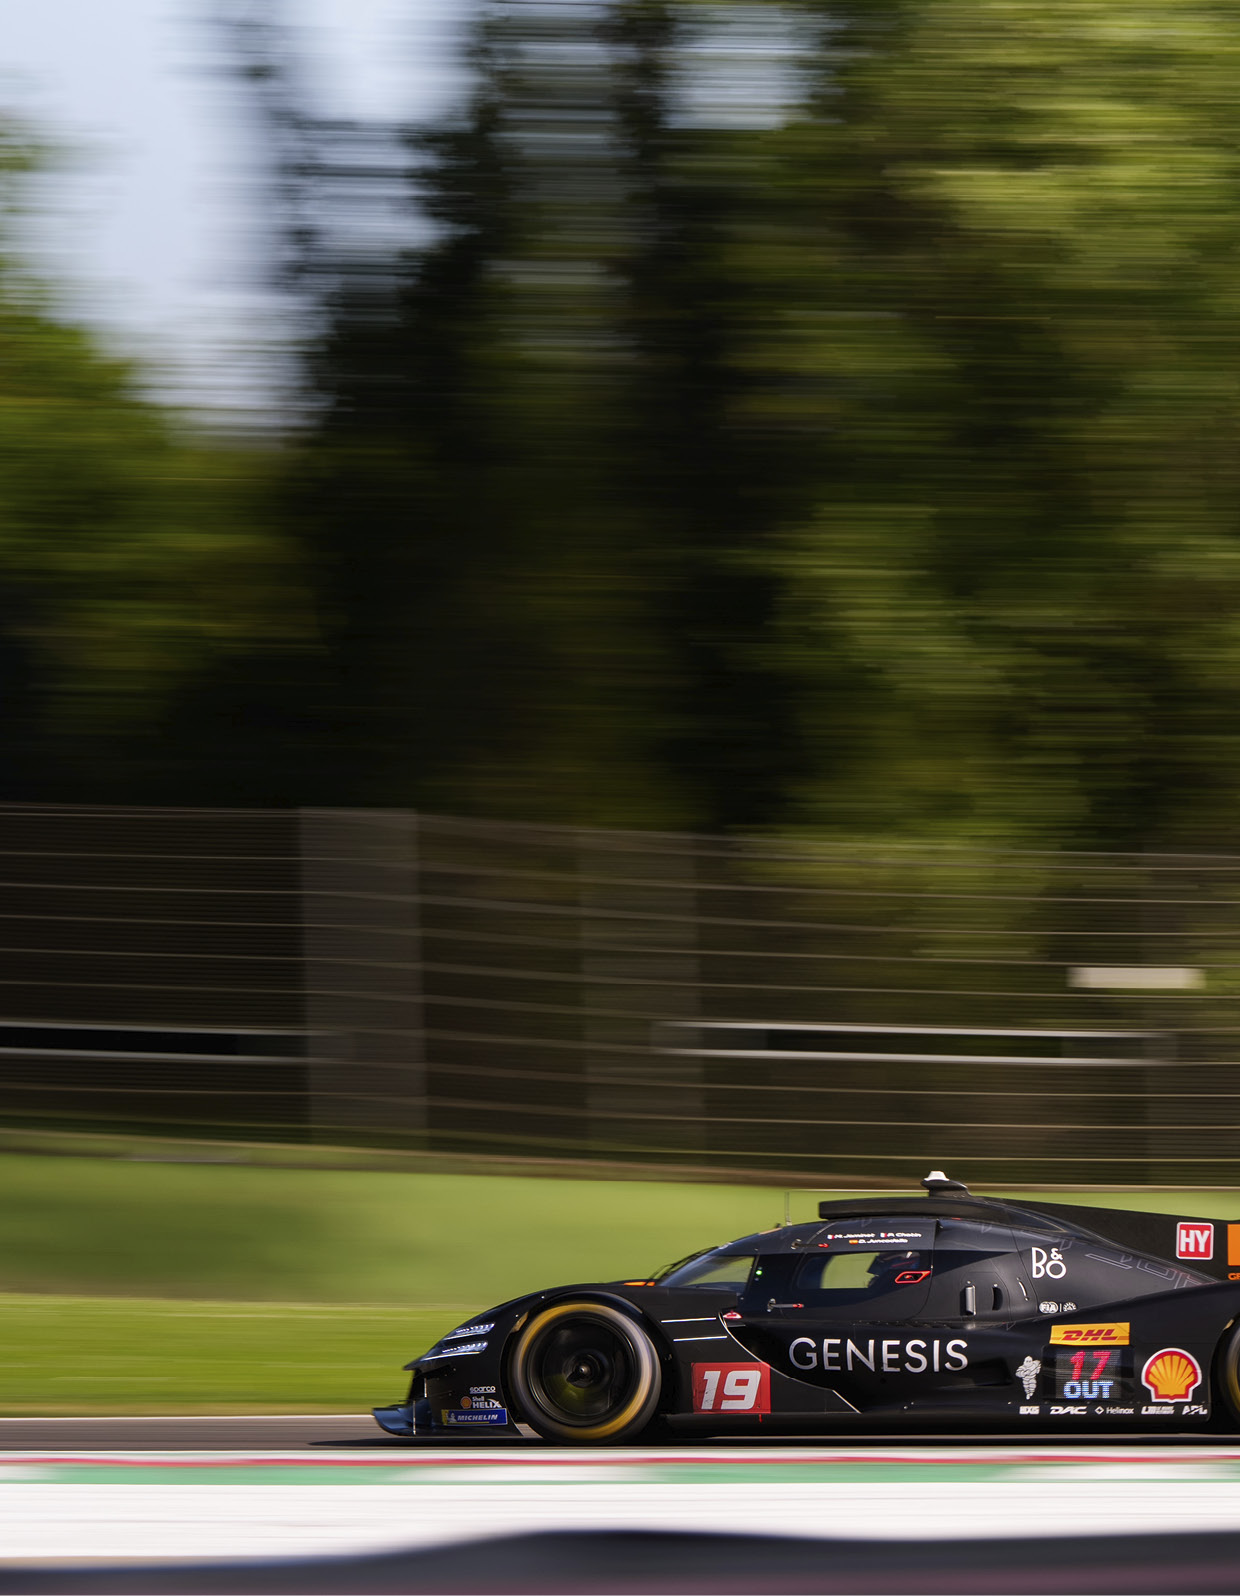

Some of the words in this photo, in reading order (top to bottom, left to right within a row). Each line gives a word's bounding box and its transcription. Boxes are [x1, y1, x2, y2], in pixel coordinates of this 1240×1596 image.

[1179, 1229, 1211, 1253] HY
[1061, 1328, 1118, 1342] DHL
[788, 1337, 969, 1373] GENESIS
[1070, 1350, 1112, 1381] 17
[469, 1385, 496, 1393] sparco
[701, 1370, 762, 1410] 19
[1063, 1380, 1114, 1399] OUT
[473, 1398, 502, 1409] HELIX
[1050, 1405, 1088, 1415] DAC
[1106, 1406, 1134, 1415] Helinox
